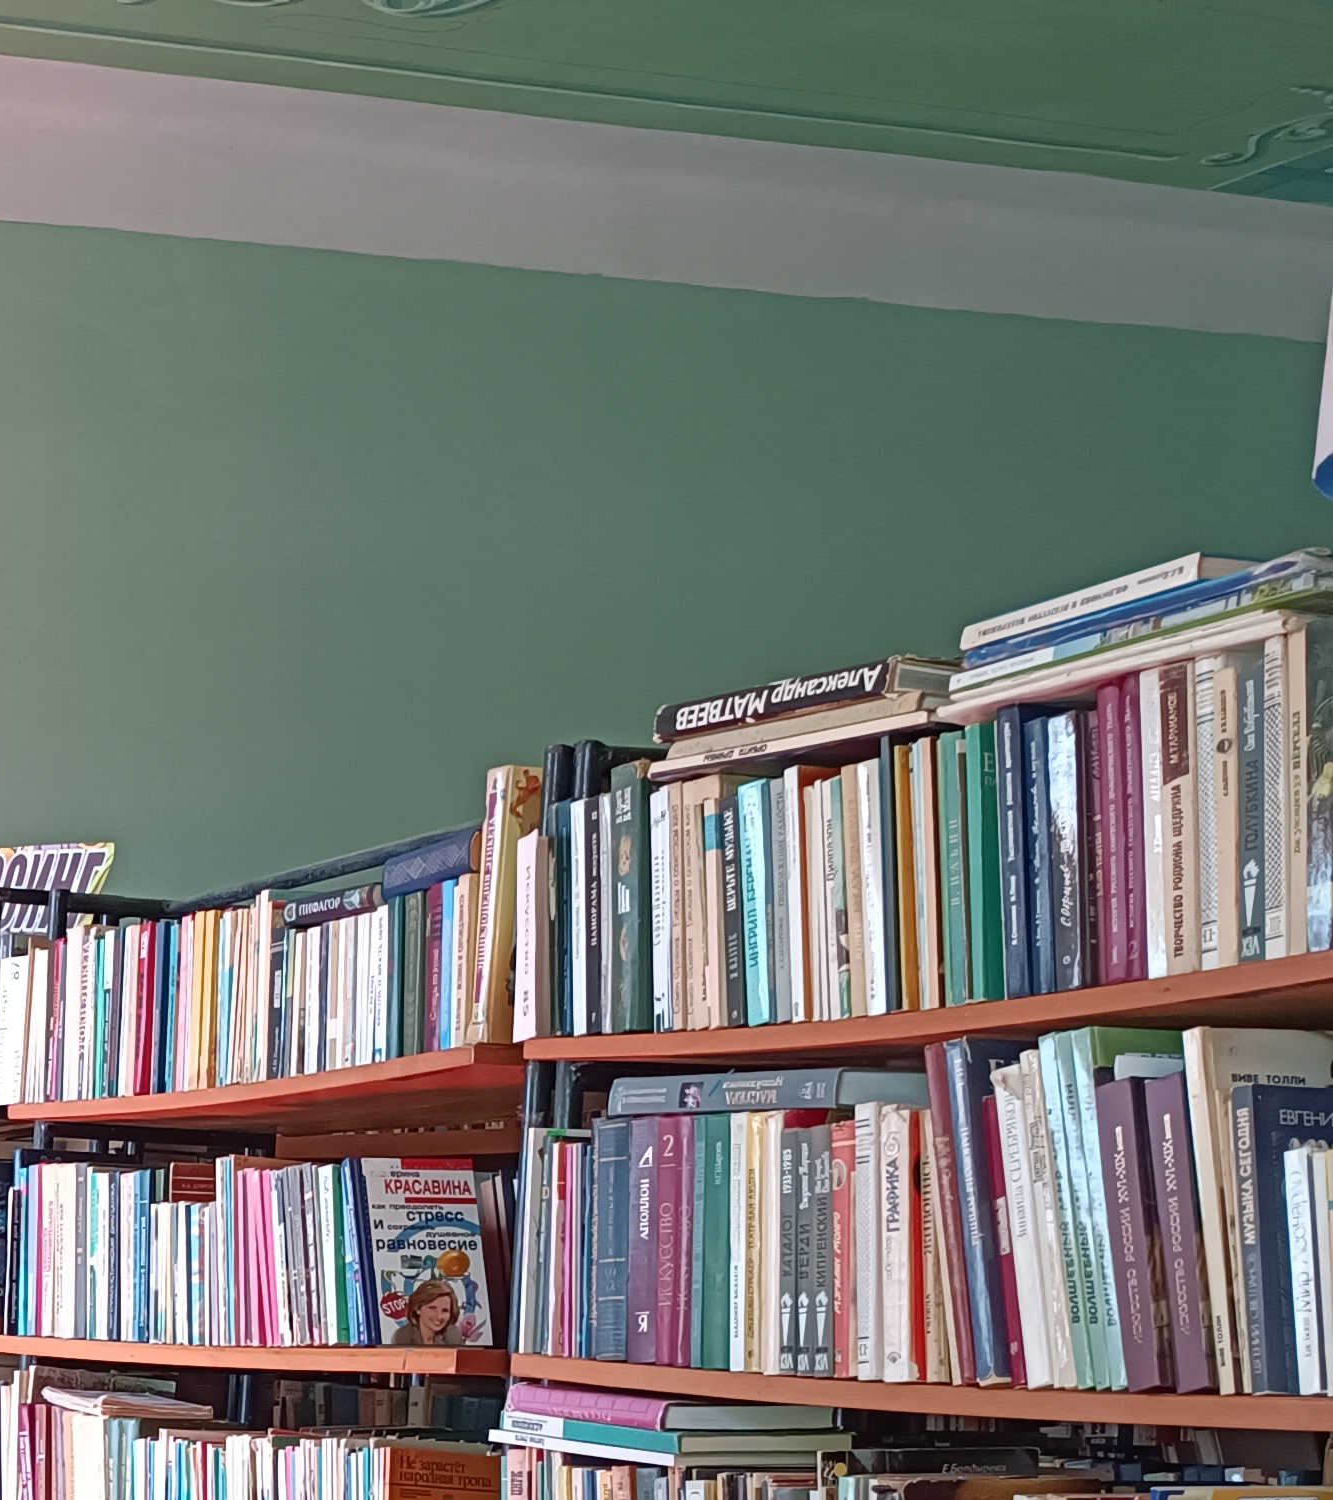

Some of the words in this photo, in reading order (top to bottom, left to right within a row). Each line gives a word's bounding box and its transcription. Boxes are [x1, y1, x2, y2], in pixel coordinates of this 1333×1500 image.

[675, 690, 768, 730] МАТВЕЕВ
[770, 664, 882, 703] Александр
[1170, 784, 1183, 837] ЩЕДРИНА
[1171, 841, 1183, 890] РОДИОНА
[299, 897, 341, 915] ПИФАГОР
[1172, 894, 1184, 958] ТВОРЧЕСТВО
[1232, 1073, 1259, 1083] ВИВЕ
[1267, 1075, 1306, 1085] ТОЛЛИ
[1237, 1107, 1252, 1176] СЕГОДНЯ
[384, 1179, 471, 1195] КРАСАВИНА
[885, 1157, 901, 1232] ГРАФИКА
[1242, 1179, 1256, 1244] МУЗЫКА
[376, 1239, 477, 1251] равновесие
[406, 1211, 464, 1224] стресс
[816, 1197, 827, 1287] КИПРЕНСКИЙ
[1120, 1207, 1135, 1262] РОССИИ
[1168, 1197, 1183, 1252] РОССИИ
[658, 1202, 672, 1306] ИСКУССТВО
[799, 1223, 810, 1280] ВЕРДИ
[1059, 1221, 1080, 1324] ВОЛШЕБНЫЙ
[1076, 1221, 1098, 1324] ВОЛШЕБНЫЙ
[1127, 1269, 1143, 1343] ИСКУССТВО
[1174, 1259, 1191, 1334] ИСКУССТВО
[399, 1454, 416, 1473] Не
[458, 1476, 491, 1488] тропа
[511, 1471, 523, 1495] ЦИРК
